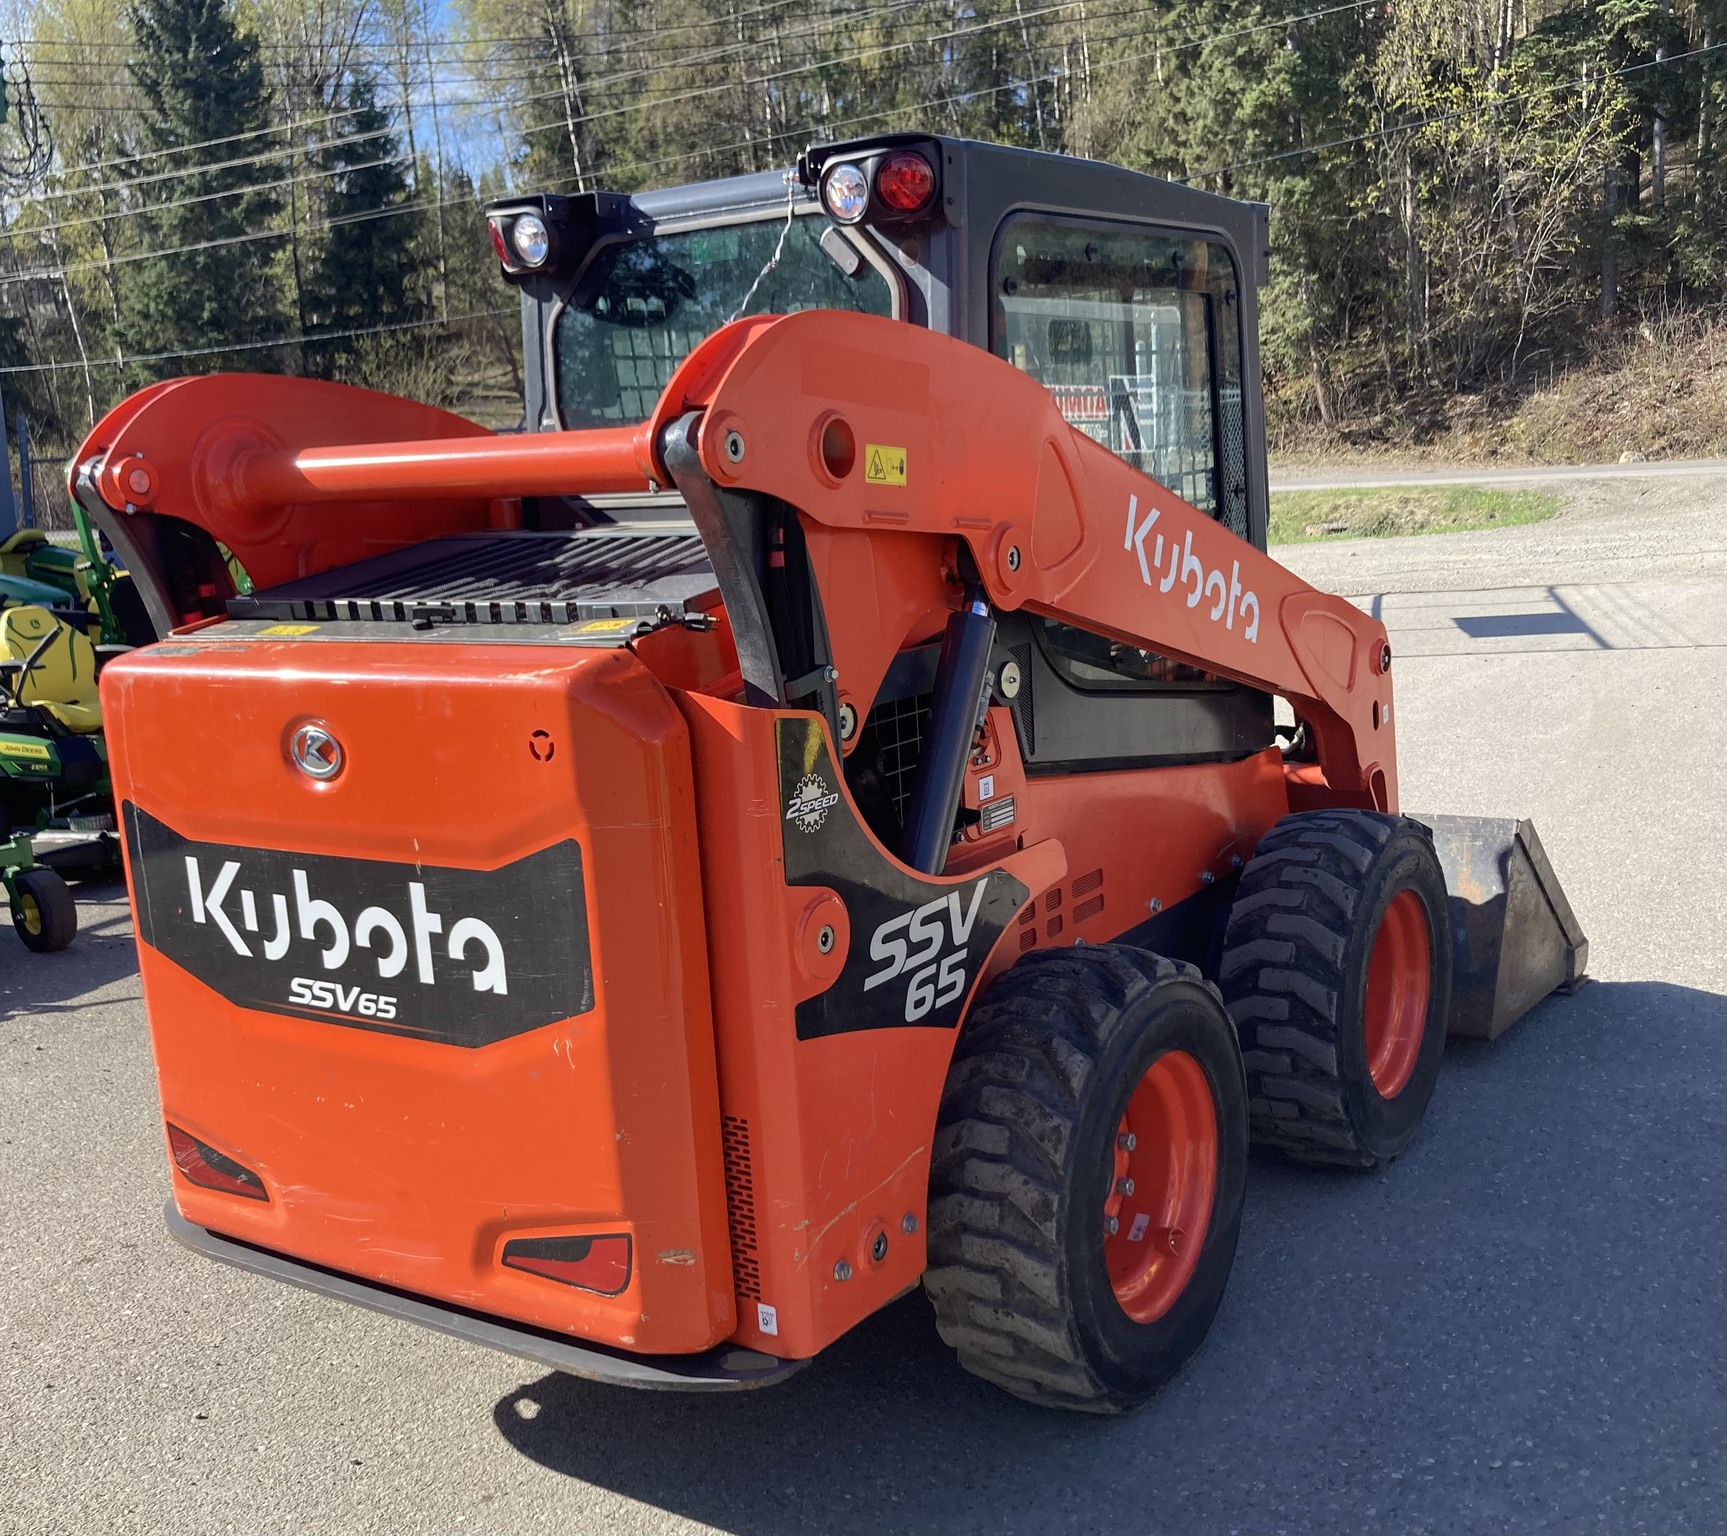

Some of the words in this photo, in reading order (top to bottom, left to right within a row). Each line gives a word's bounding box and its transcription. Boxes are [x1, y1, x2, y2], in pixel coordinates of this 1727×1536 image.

[1124, 493, 1260, 644] Kubota
[184, 855, 508, 996] Kubota
[863, 876, 989, 992] SSV
[288, 976, 398, 1020] SSV65
[904, 947, 968, 1024] 65
